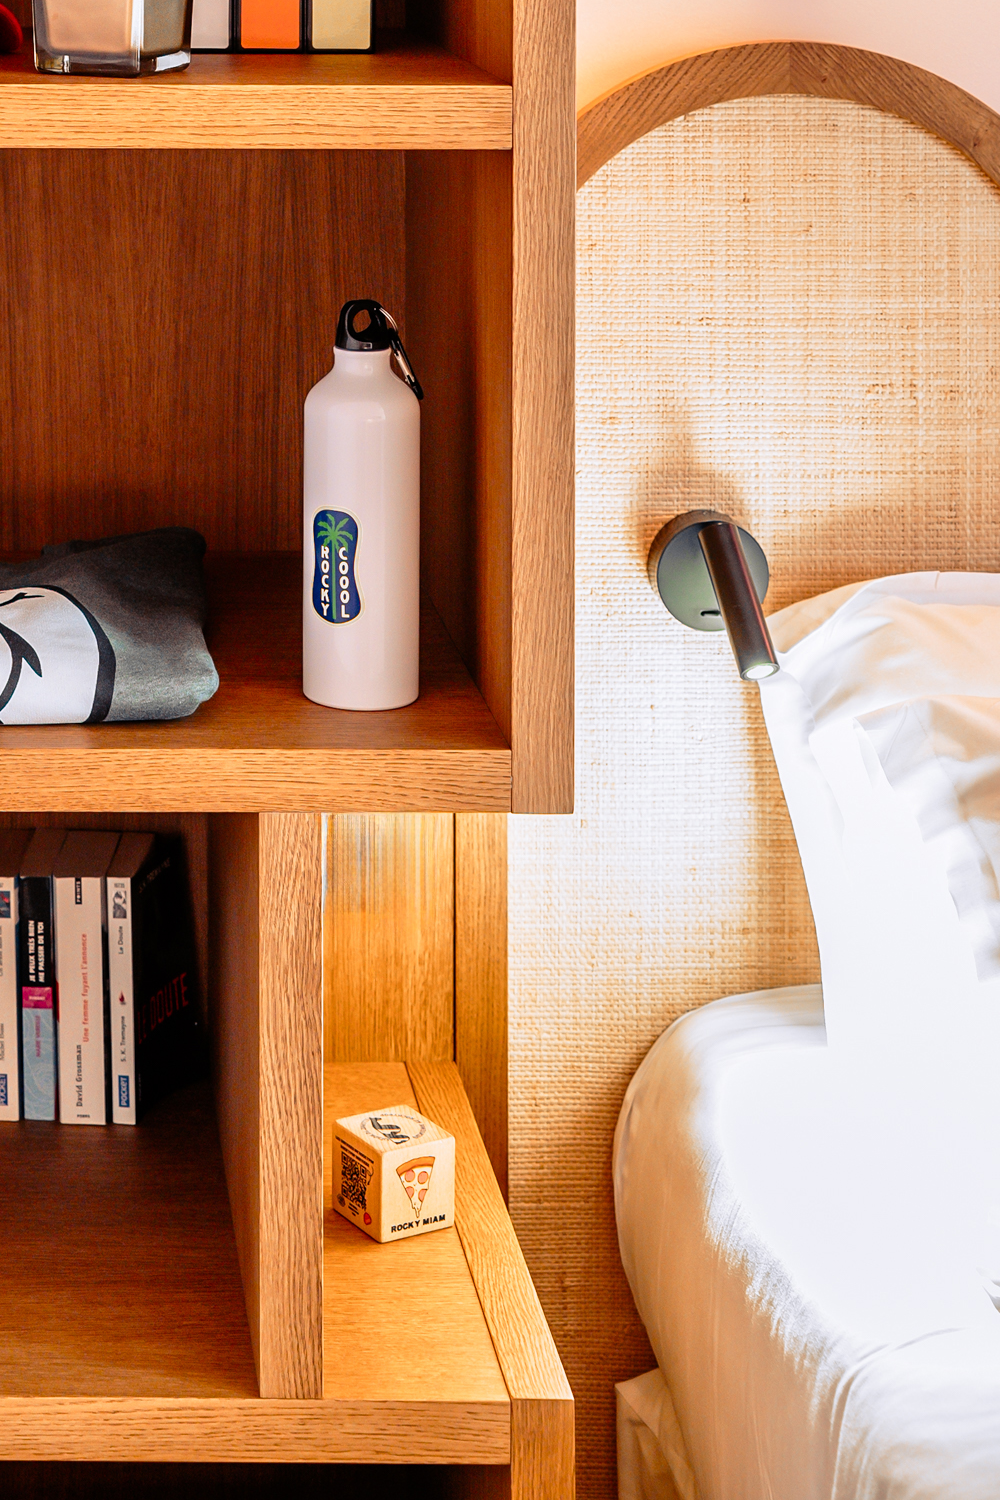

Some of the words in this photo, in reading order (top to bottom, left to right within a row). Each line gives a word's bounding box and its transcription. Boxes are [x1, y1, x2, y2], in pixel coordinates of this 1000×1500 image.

[320, 545, 330, 617] ROCKY
[338, 546, 350, 618] COOOL
[38, 935, 44, 944] DE
[119, 946, 124, 954] Le
[29, 974, 36, 983] JE
[39, 972, 45, 983] ME
[82, 972, 90, 997] fuyant
[150, 971, 189, 1031] DOUTE
[119, 1076, 128, 1106] POCKET
[391, 1220, 420, 1233] ROCKY
[423, 1213, 446, 1225] MIAM
